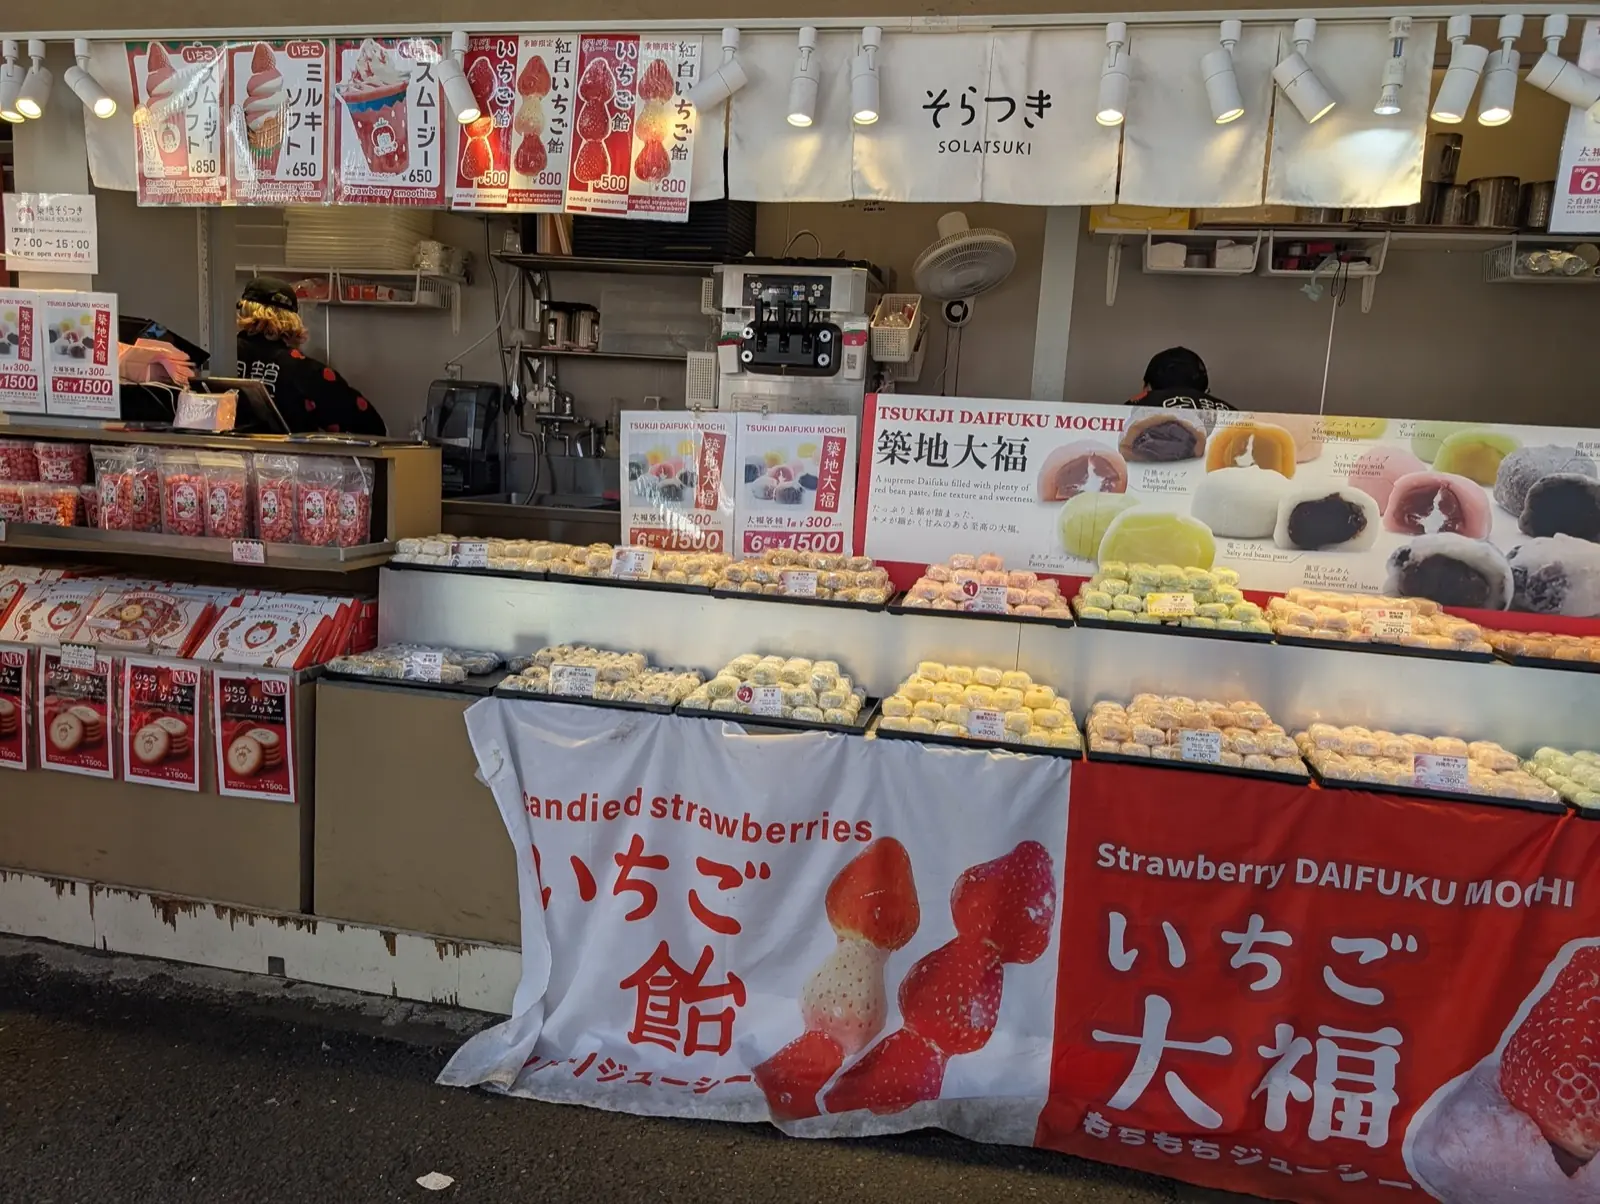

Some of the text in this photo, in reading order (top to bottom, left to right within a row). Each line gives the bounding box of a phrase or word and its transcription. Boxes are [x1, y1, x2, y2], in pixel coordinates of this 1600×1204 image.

[291, 44, 320, 56] いちご
[612, 41, 636, 131] いちご飴
[547, 38, 572, 153] 紅白いちご飴
[670, 41, 697, 160] 紅白いちご飴
[305, 64, 322, 155] ミルキー
[416, 62, 435, 167] スムージー
[922, 86, 1052, 129] そらつき
[286, 88, 302, 155] ソフト
[938, 140, 1031, 155] SOLATSUKI
[191, 160, 216, 173] ¥850
[286, 163, 316, 177] ¥650
[402, 170, 432, 182] ¥650
[479, 171, 507, 185] ¥500
[533, 172, 561, 185] ¥800
[593, 176, 627, 190] ¥500
[344, 186, 437, 198] Strawberry smoothies
[655, 179, 686, 193] ¥800
[21, 310, 31, 359] 築地大福
[96, 313, 107, 363] 築地大福
[73, 379, 111, 394] ¥1500
[878, 406, 1126, 432] TSUKIJI DAIFUKU MOCHI
[746, 424, 776, 432] TSUKIJI
[778, 425, 815, 433] DAIFUKU
[1312, 428, 1336, 436] Mango
[876, 429, 1030, 472] 築地大福
[1333, 461, 1368, 470] Strawberry
[1333, 468, 1360, 476] whipped
[819, 440, 842, 509] 築地大福
[884, 476, 915, 485] supreme
[917, 477, 949, 487] Daifuku
[951, 479, 971, 488] filled
[973, 480, 991, 489] with
[993, 482, 1019, 492] plenty
[1021, 483, 1031, 492] of
[909, 490, 930, 498] paste,
[932, 490, 947, 498] fine
[950, 491, 977, 500] texture
[996, 494, 1036, 504] sweetness.
[799, 516, 832, 527] ¥300
[778, 533, 840, 552] ¥1500
[969, 585, 974, 595] 1
[1360, 583, 1379, 591] beans
[2, 653, 25, 663] NEW
[173, 671, 197, 683] NEW
[262, 681, 287, 694] NEW
[250, 704, 282, 714] クッキー
[523, 788, 873, 844] candied strawberries
[1097, 843, 1285, 888] Strawberry
[1295, 858, 1457, 905] DAIFUKU
[531, 833, 772, 935] いちご
[1108, 910, 1418, 1006] いちご
[620, 940, 747, 1056] 飴
[1092, 994, 1403, 1148] 大福
[1082, 1111, 1413, 1190] もちもちジューシー
